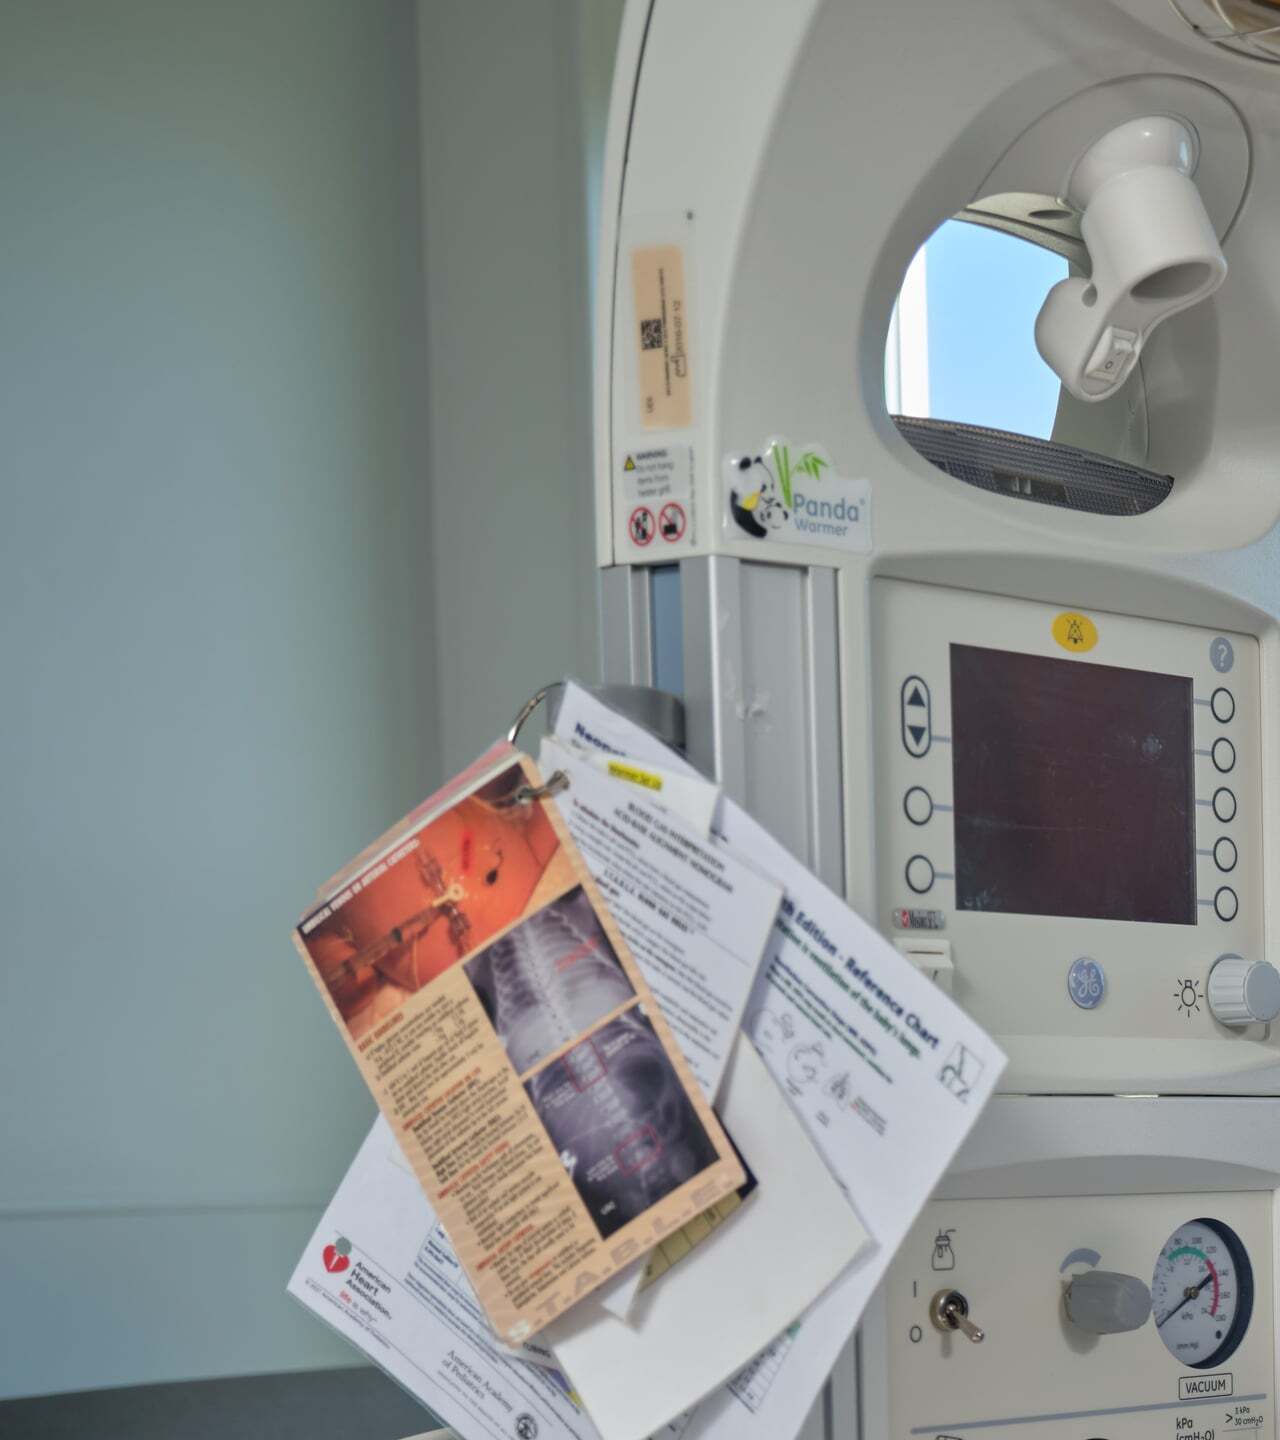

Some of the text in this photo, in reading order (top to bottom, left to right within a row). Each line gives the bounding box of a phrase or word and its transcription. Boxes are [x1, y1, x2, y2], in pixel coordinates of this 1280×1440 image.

[794, 518, 848, 536] Warmer
[794, 911, 838, 956] Edition
[845, 957, 904, 1016] Reference
[904, 1012, 940, 1049] Chart
[349, 1269, 380, 1295] Heart
[353, 1261, 394, 1293] American
[446, 1349, 484, 1383] American
[480, 1380, 515, 1412] Academy
[449, 1365, 487, 1399] Pediatrics
[1185, 1379, 1227, 1394] VACUUM
[1240, 1406, 1250, 1414] kPa
[1176, 1418, 1193, 1430] kPa
